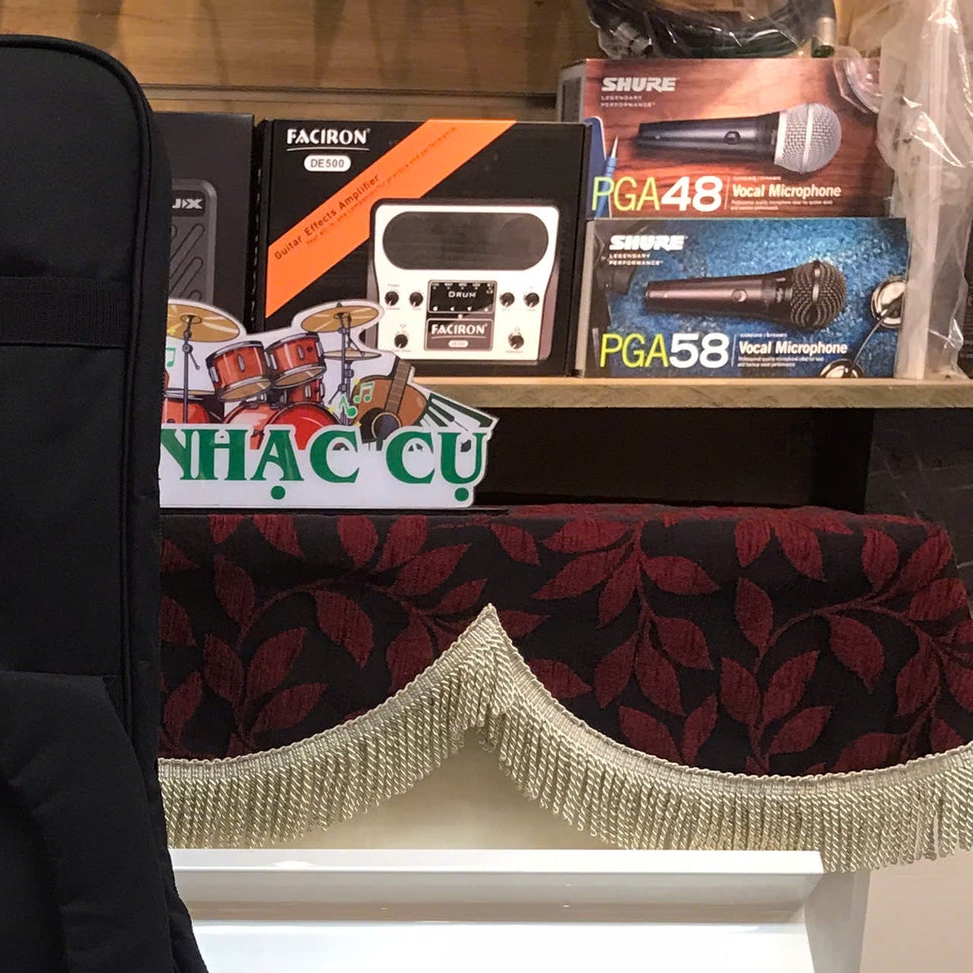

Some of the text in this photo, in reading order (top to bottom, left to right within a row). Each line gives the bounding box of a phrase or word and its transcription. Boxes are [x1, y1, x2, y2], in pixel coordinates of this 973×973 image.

[601, 77, 677, 93] SHURE
[286, 128, 368, 145] FACIRON
[310, 158, 345, 169] DE500
[591, 175, 724, 212] PGA48
[732, 183, 842, 200] Vocal Microphone
[171, 198, 203, 209] UX
[274, 174, 380, 260] Guitar Effects Amplifier
[609, 234, 685, 252] SHURE
[431, 323, 486, 335] FACIRON
[599, 332, 730, 369] PGA58
[738, 341, 849, 357] Vocal Microphone
[160, 428, 488, 502] NHẠC CỤ
